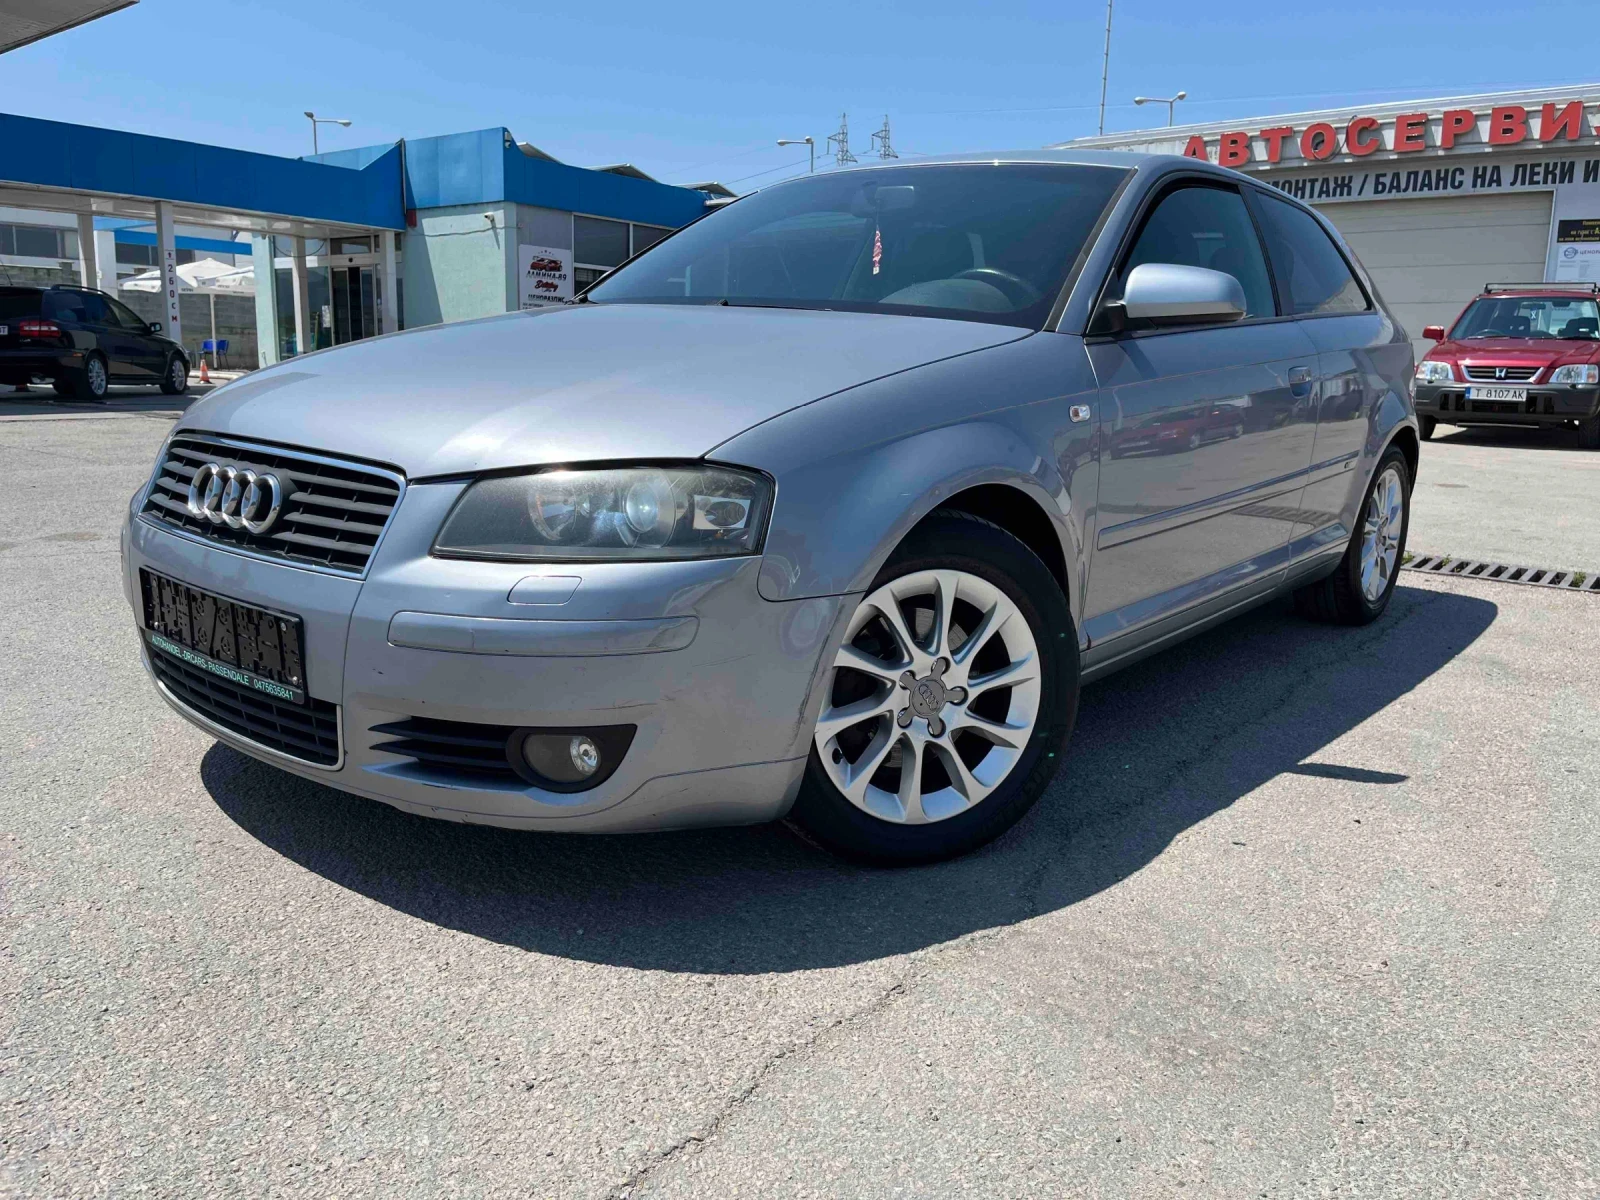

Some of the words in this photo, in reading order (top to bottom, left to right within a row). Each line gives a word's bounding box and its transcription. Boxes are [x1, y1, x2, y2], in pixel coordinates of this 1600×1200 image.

[1373, 166, 1465, 195] БАЛАНС
[1471, 165, 1502, 188] НА
[1509, 160, 1576, 187] ЛЕКИ
[1582, 159, 1600, 183] И
[1486, 389, 1510, 399] 8107
[1511, 390, 1524, 400] AK
